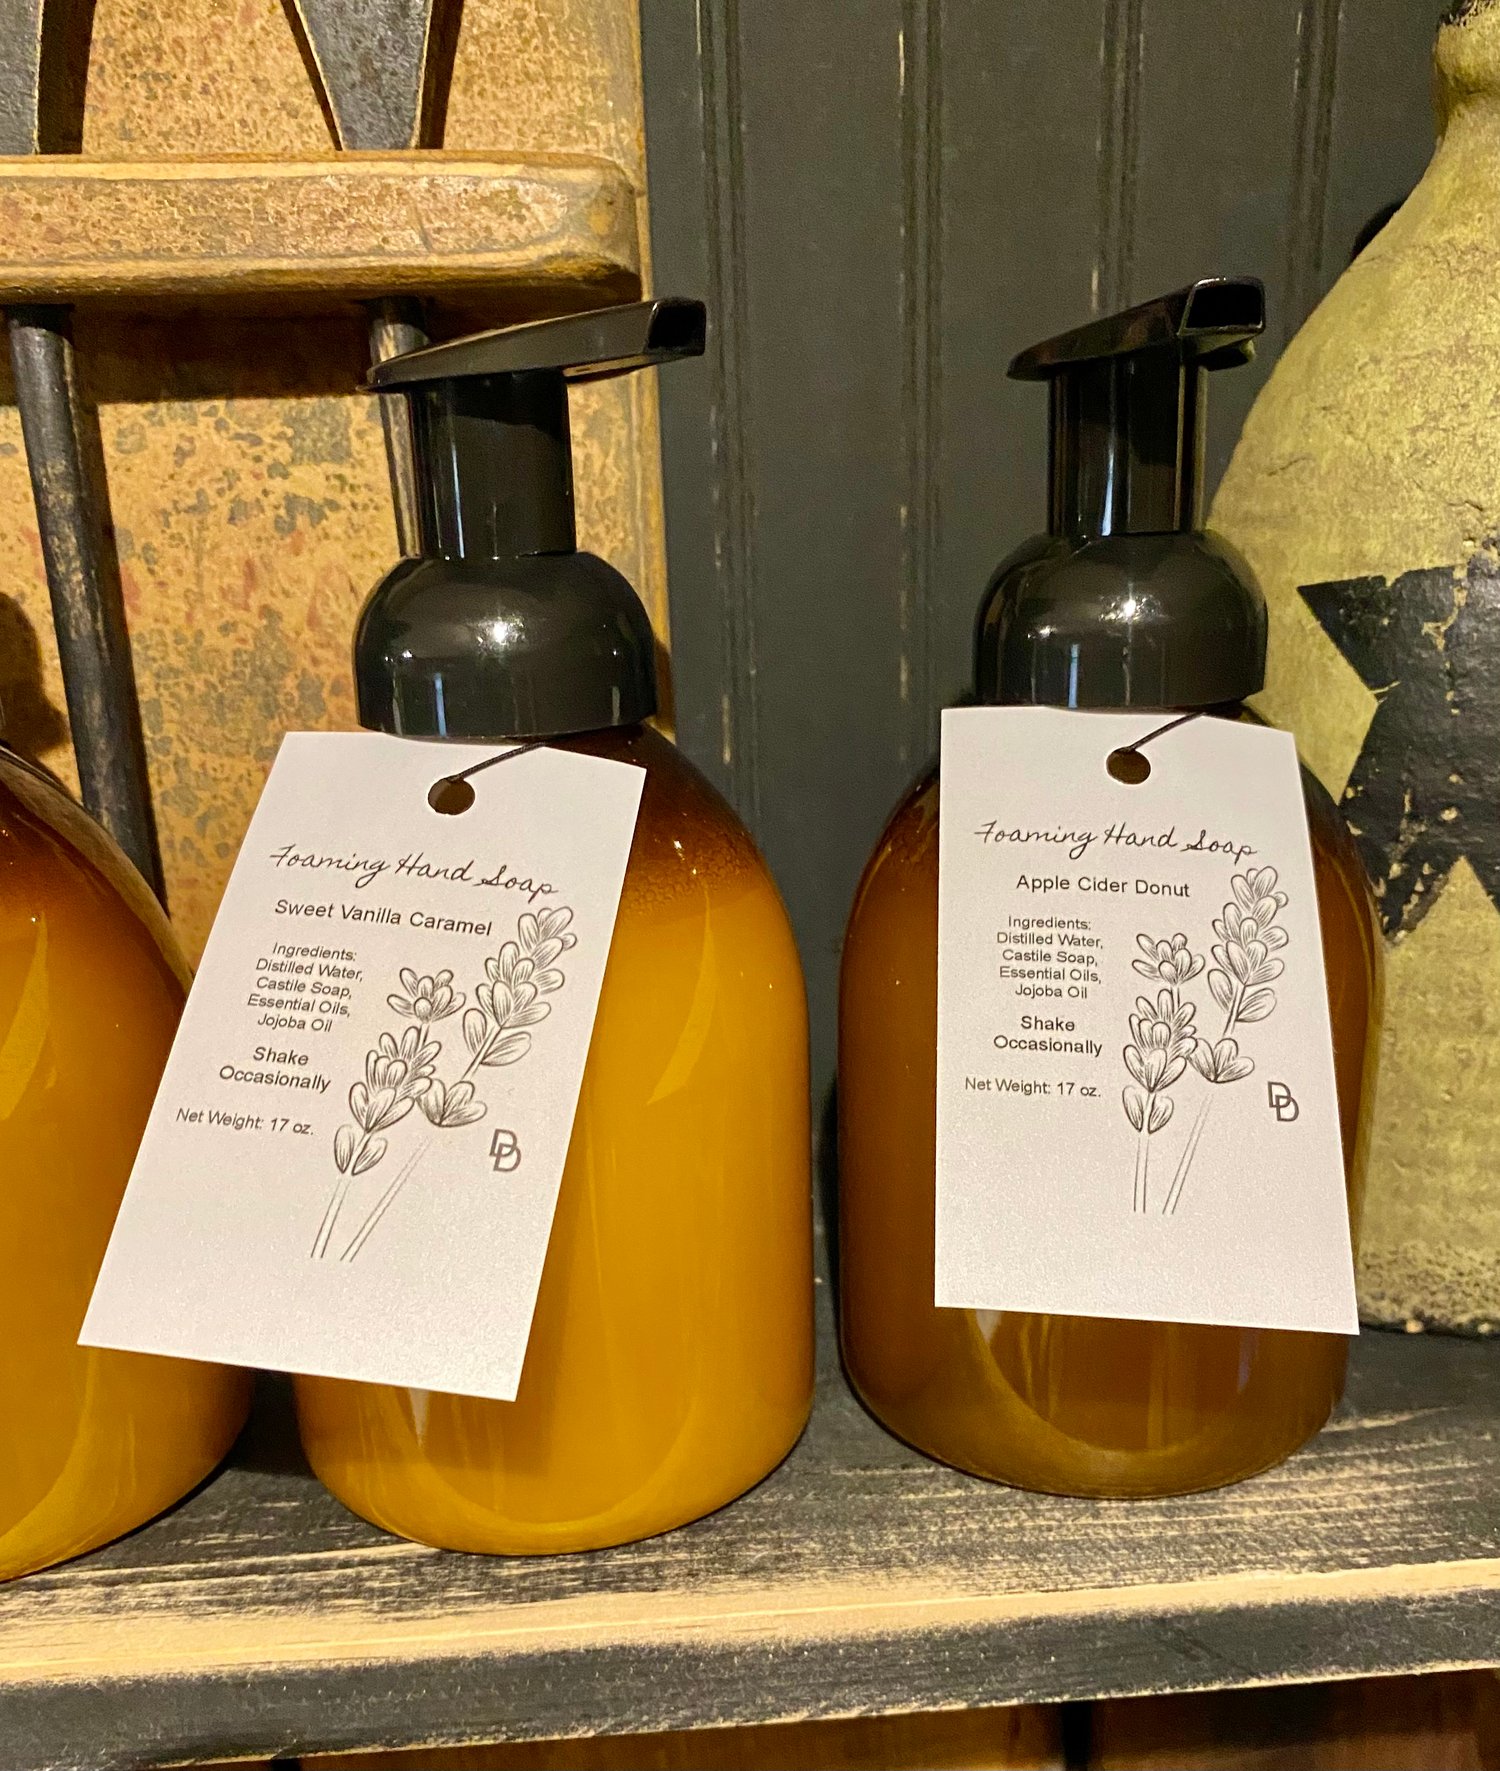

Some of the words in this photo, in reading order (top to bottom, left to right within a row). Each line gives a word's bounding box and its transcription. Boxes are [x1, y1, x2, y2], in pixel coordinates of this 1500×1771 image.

[974, 820, 1097, 860] Foaming
[1104, 822, 1178, 848] Hand
[1180, 830, 1257, 865] Soap
[269, 844, 390, 889] Foaming
[395, 852, 475, 883] Hand
[472, 865, 559, 903] Soap
[1016, 875, 1070, 893] Apple
[1078, 876, 1127, 893] Cider
[1135, 880, 1190, 897] Donut
[274, 899, 335, 920] Sweet
[341, 904, 402, 925] Vanilla
[409, 912, 493, 936] Caramel
[1008, 915, 1092, 932] Ingredients:
[996, 932, 1053, 945] Distilled
[1058, 934, 1104, 950] Water,
[272, 942, 357, 962] Ingredients:
[1002, 949, 1051, 963] Castile
[1056, 951, 1098, 967] Soap,
[255, 958, 315, 976] Distilled
[318, 963, 364, 981] Water,
[999, 966, 1065, 980] Essential
[1069, 968, 1101, 984] Oils,
[256, 976, 307, 994] Castile
[311, 982, 352, 999] Soap,
[1015, 983, 1063, 999] Jojoba
[1067, 986, 1087, 999] Oil
[247, 993, 316, 1012] Essential
[319, 999, 351, 1017] Oils,
[257, 1013, 307, 1031] Jojoba
[311, 1016, 332, 1033] Oil
[1020, 1016, 1075, 1032] Shake
[252, 1046, 309, 1066] Shake
[993, 1035, 1103, 1058] Occasionally
[219, 1065, 331, 1094] Occasionally
[965, 1077, 991, 1091] Net
[995, 1078, 1051, 1096] Weight:
[1057, 1082, 1075, 1096] 17
[1080, 1085, 1101, 1097] oz.
[176, 1108, 205, 1123] Net
[208, 1110, 264, 1132] Weight:
[270, 1118, 289, 1132] 17
[292, 1122, 314, 1135] oz.
